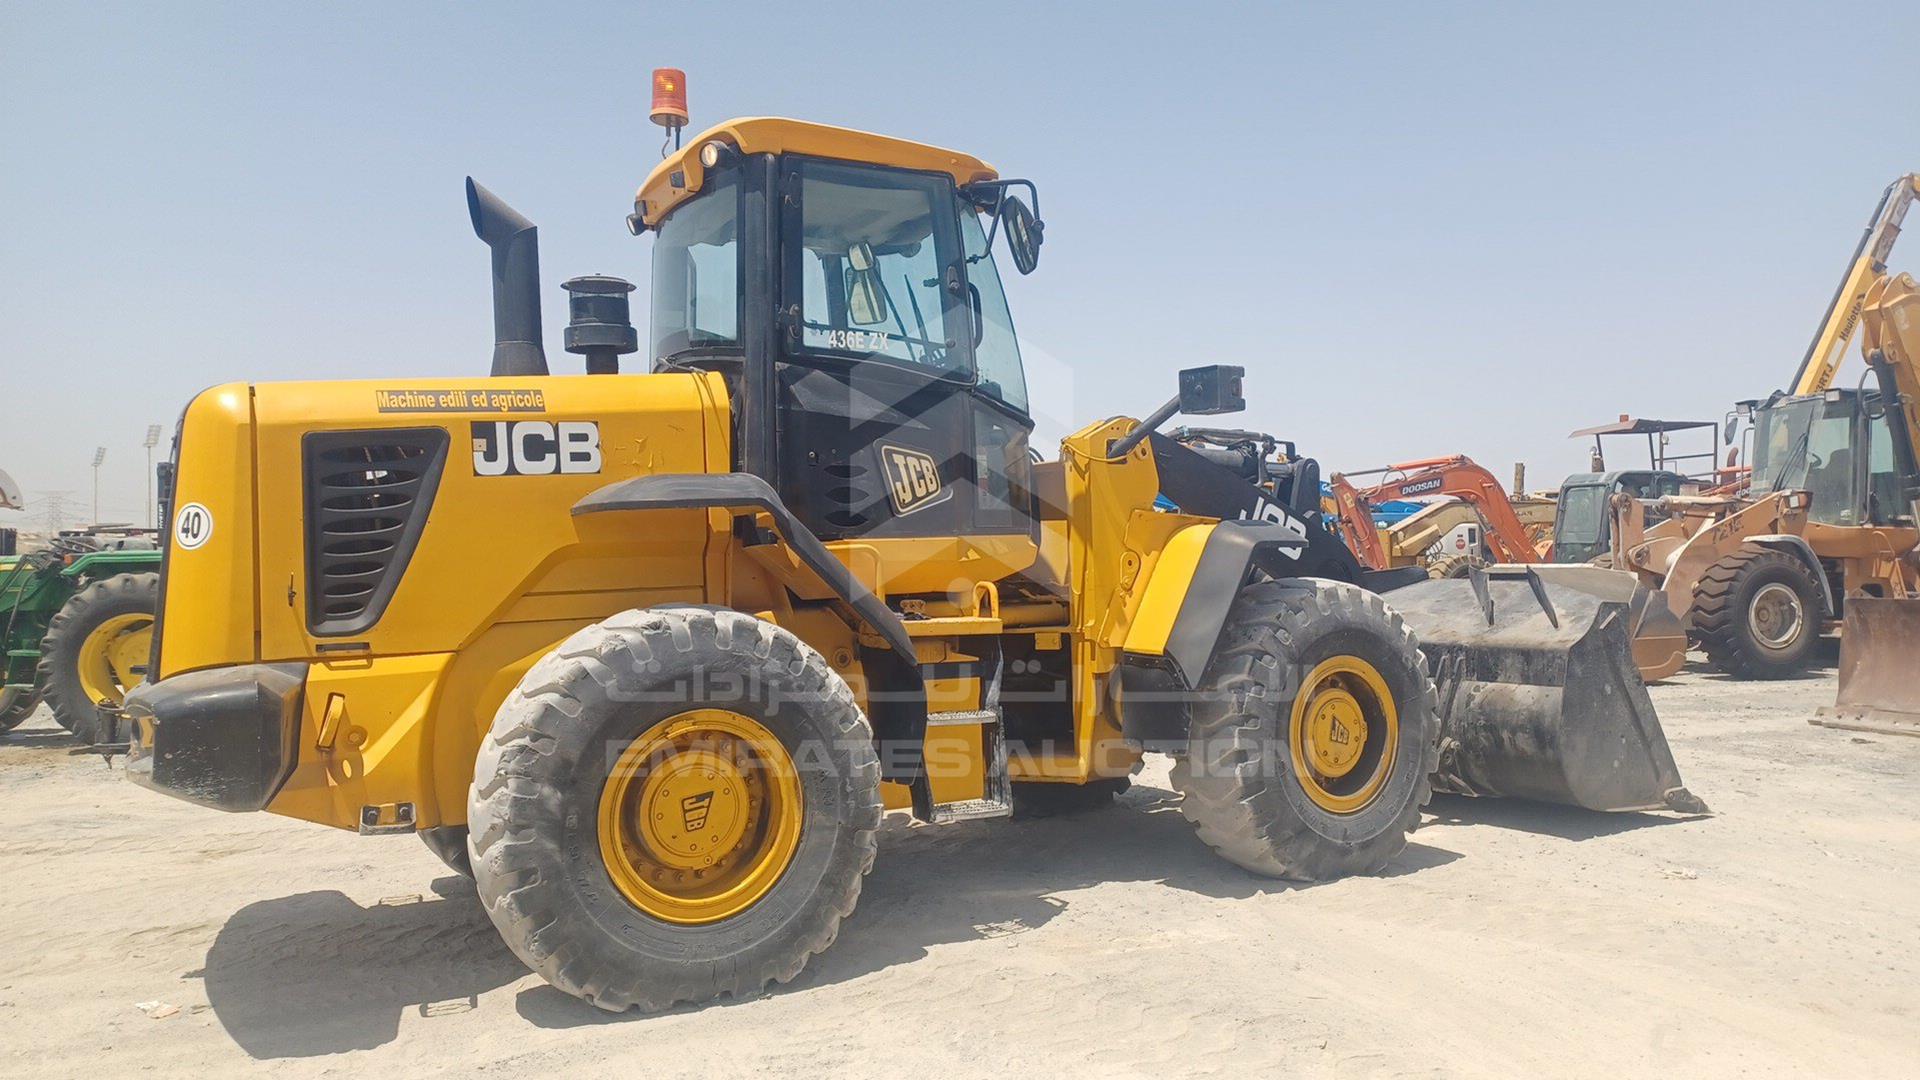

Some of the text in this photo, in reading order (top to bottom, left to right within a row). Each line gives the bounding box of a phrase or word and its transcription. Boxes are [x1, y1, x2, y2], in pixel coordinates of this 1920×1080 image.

[828, 329, 889, 350] 436E ZX
[378, 391, 544, 411] Machine edili ed agricole
[473, 421, 601, 475] JCB
[892, 453, 939, 505] JCB
[1401, 479, 1441, 495] DOOSAN
[181, 511, 202, 539] 40
[682, 792, 712, 832] JCB
